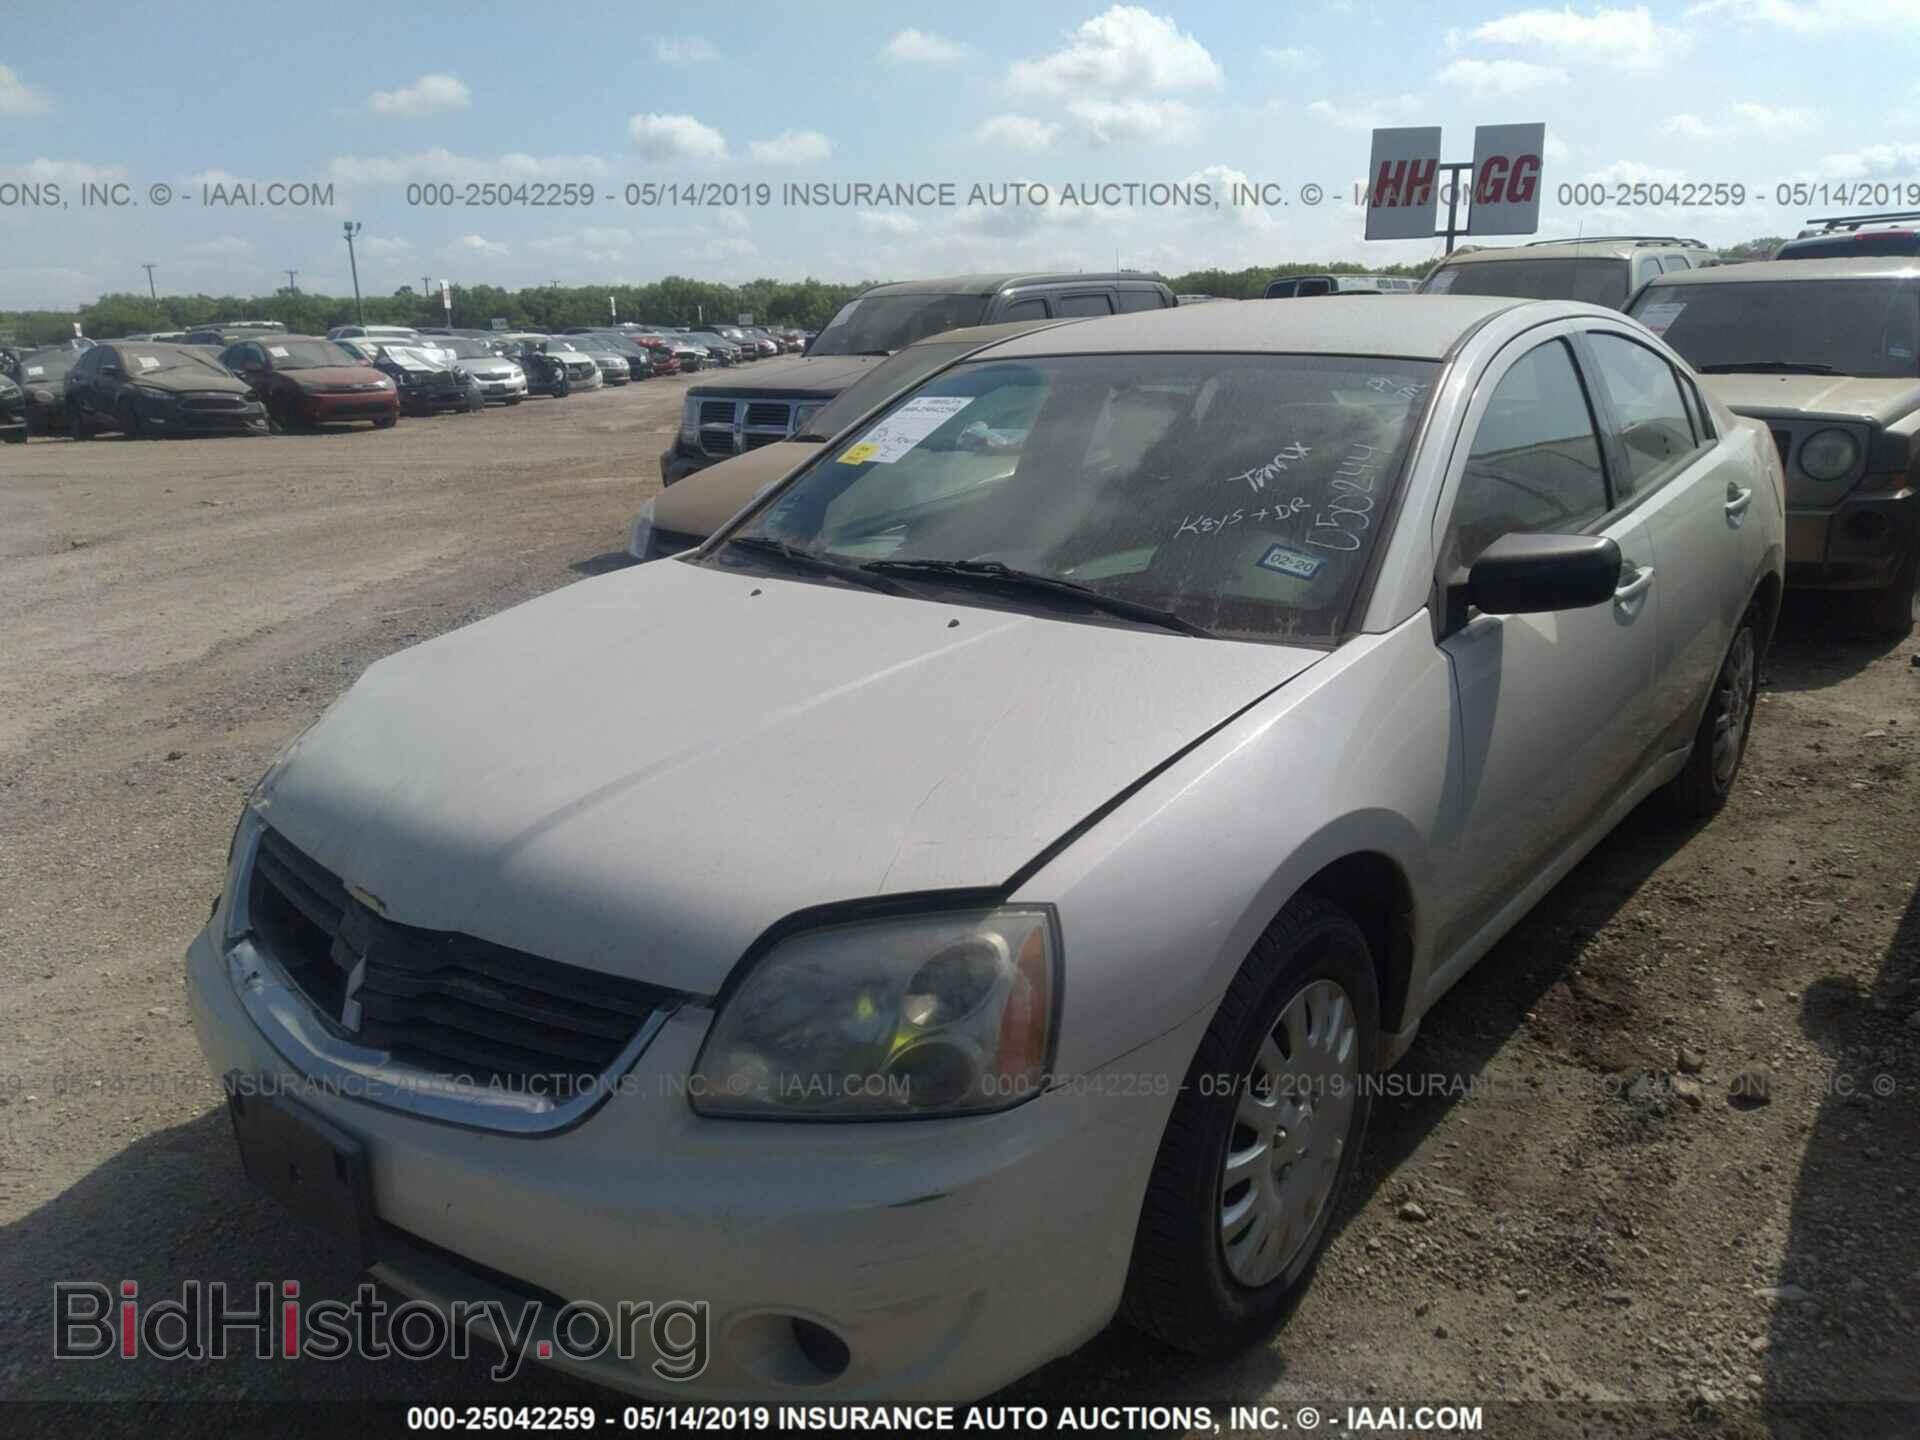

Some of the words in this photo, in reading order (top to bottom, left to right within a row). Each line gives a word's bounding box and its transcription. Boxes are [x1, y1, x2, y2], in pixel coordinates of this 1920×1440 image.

[1371, 158, 1438, 209] HH
[1472, 154, 1542, 206] GG
[1275, 496, 1312, 521] DR
